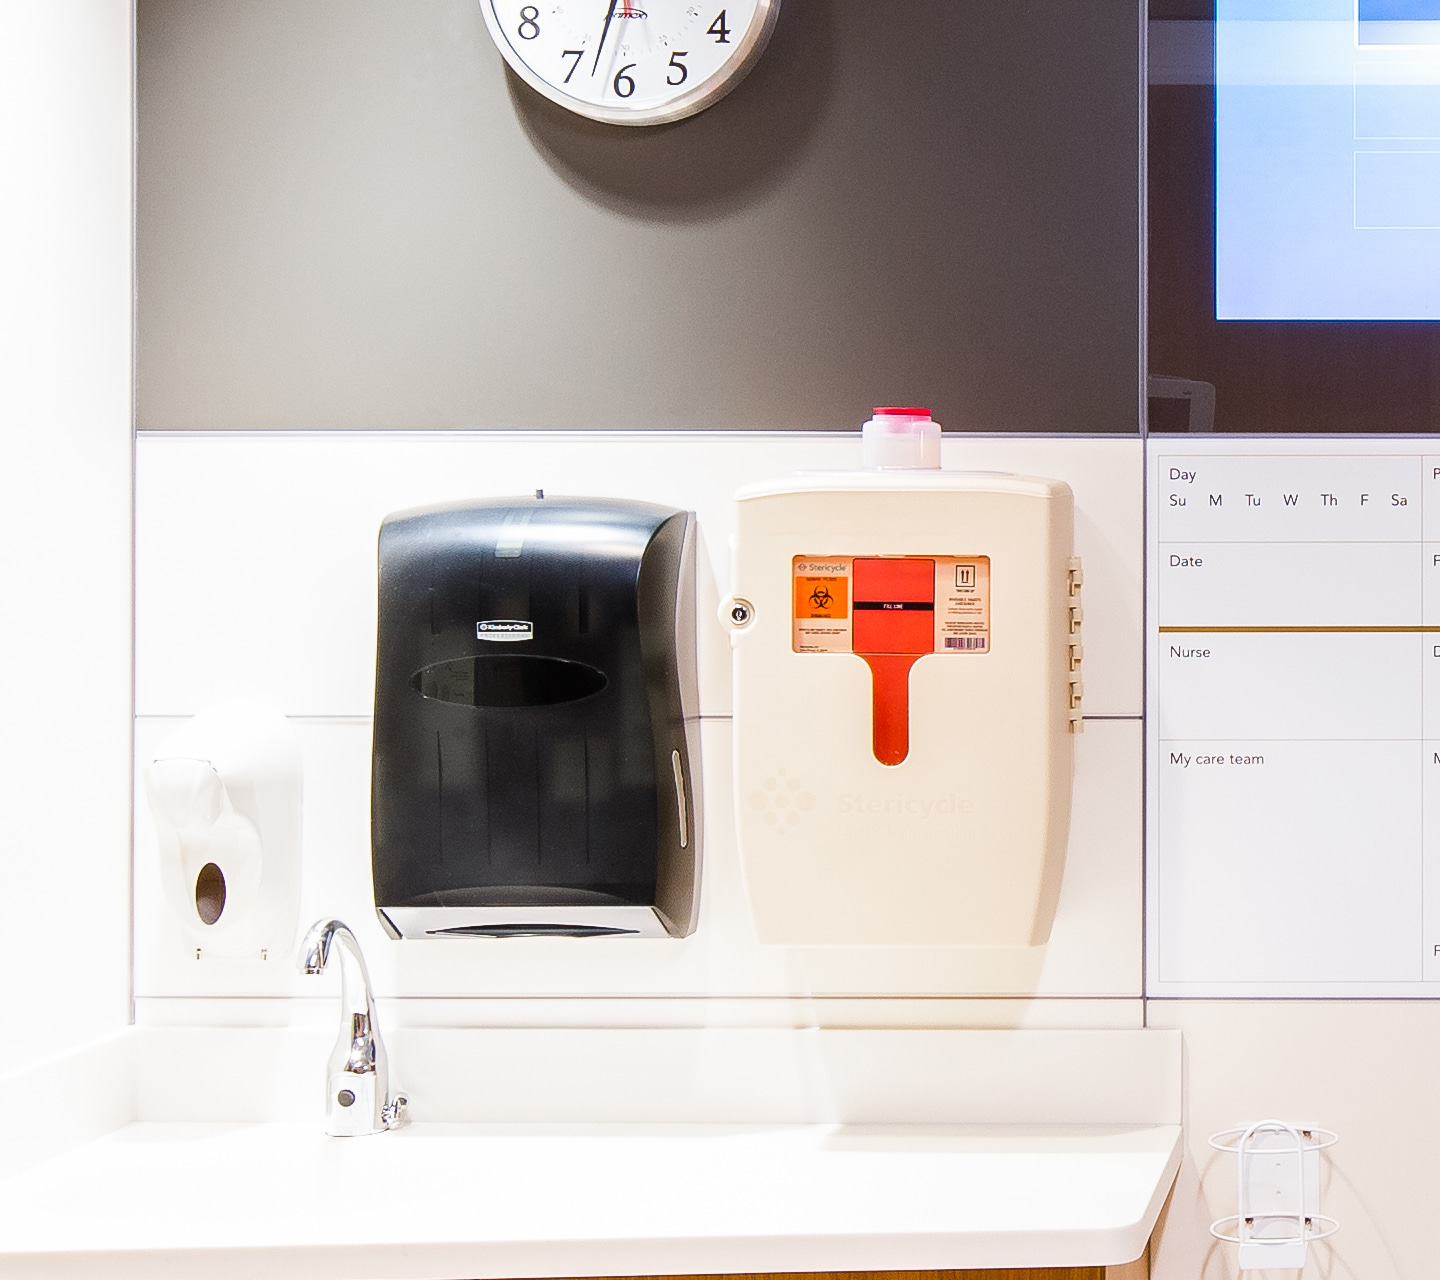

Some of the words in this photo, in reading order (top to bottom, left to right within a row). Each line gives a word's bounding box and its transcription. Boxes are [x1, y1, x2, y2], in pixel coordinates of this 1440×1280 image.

[517, 5, 541, 41] 8
[705, 9, 732, 44] 4
[561, 49, 586, 84] 7
[666, 51, 689, 86] 5
[613, 63, 637, 99] 6
[1169, 467, 1197, 484] Day
[1169, 493, 1187, 507] Su
[1209, 493, 1223, 507] M
[1244, 493, 1261, 507] Tu
[1282, 493, 1299, 507] W
[1319, 492, 1338, 507] Th
[1360, 493, 1370, 507] F
[1391, 493, 1408, 507] Sa
[809, 563, 846, 573] Stericycle
[1169, 554, 1203, 568] Date
[1170, 645, 1211, 659] Nurse
[1170, 752, 1192, 769] My
[1195, 755, 1225, 765] care
[1229, 753, 1265, 765] team
[837, 792, 974, 820] Stericycle
